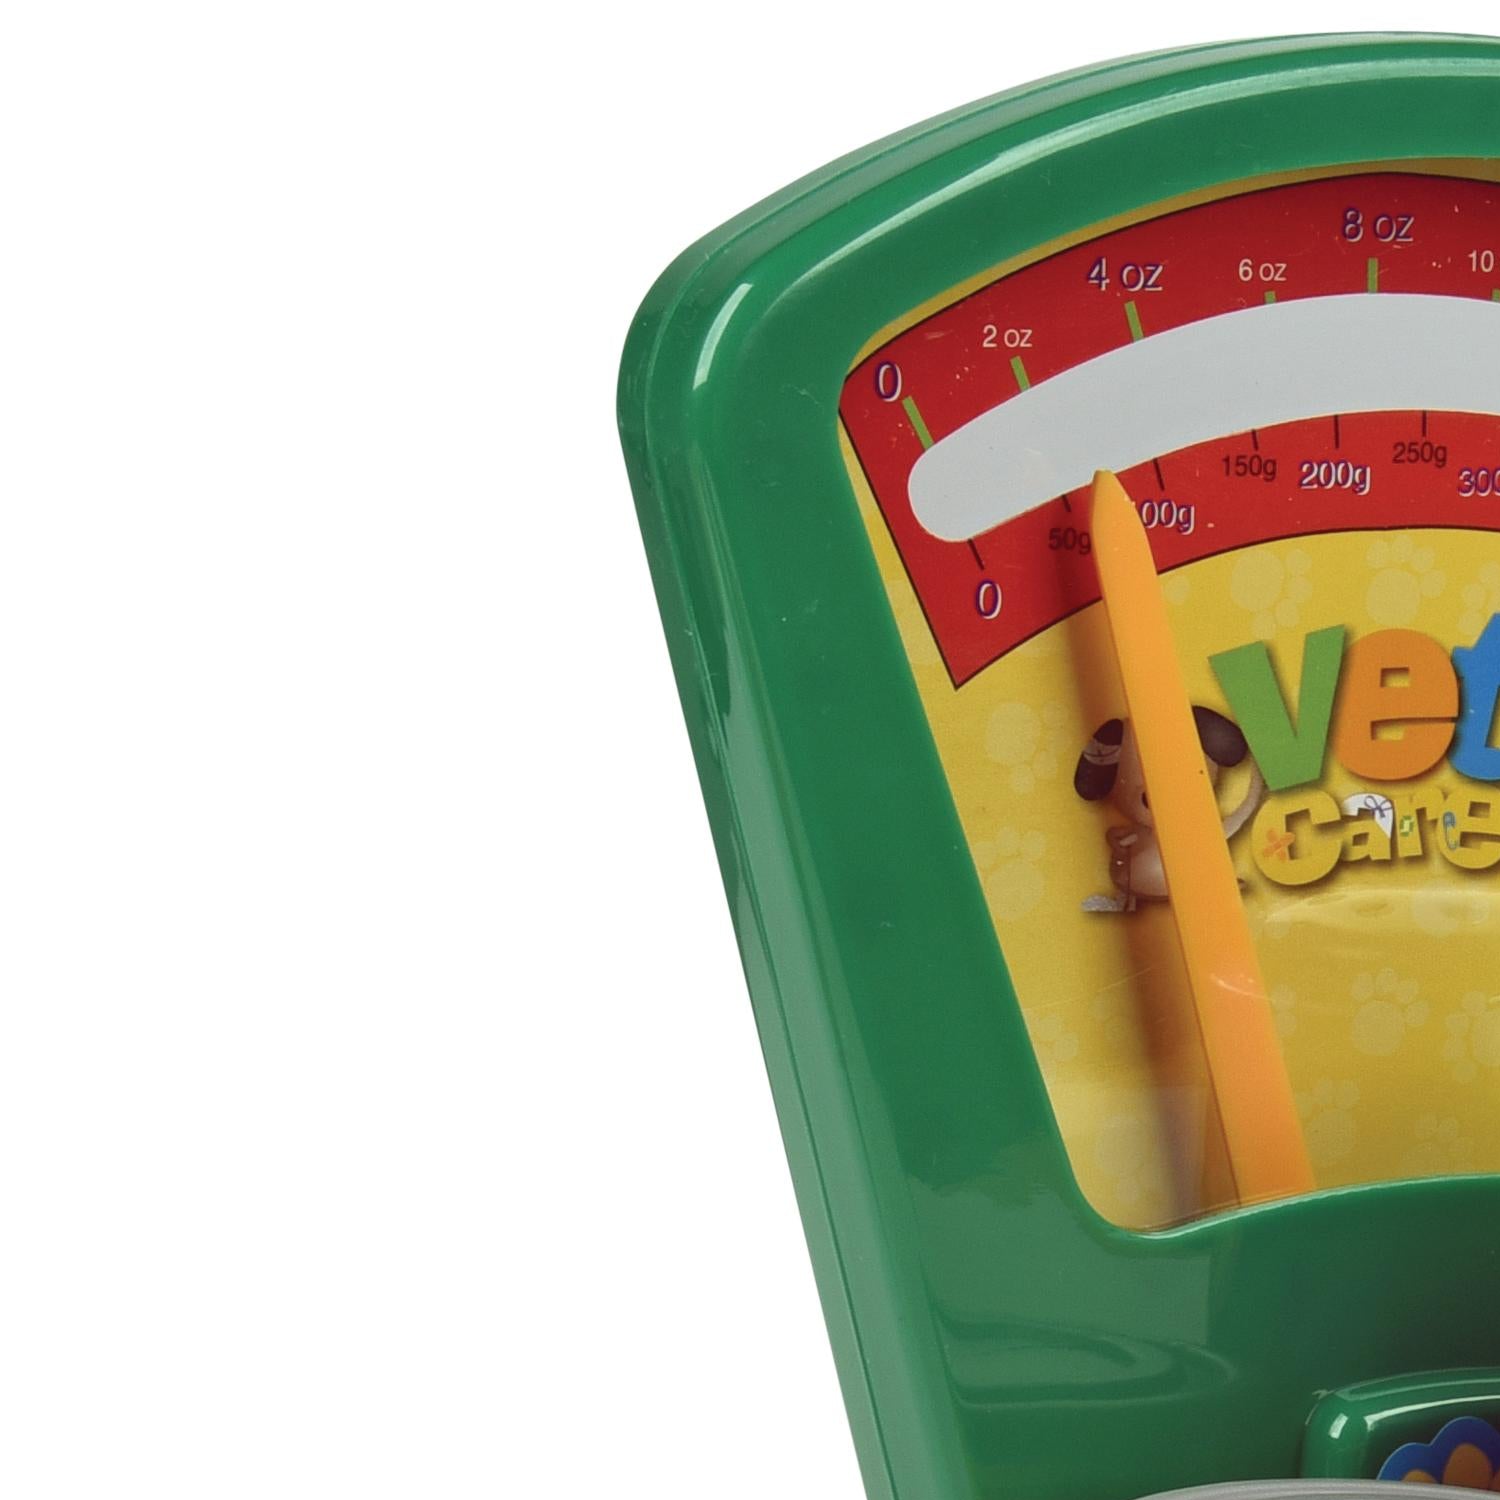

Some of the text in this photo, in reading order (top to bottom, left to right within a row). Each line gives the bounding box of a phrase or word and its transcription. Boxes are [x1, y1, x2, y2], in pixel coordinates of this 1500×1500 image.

[1342, 209, 1415, 243] 8 oz
[1087, 257, 1164, 292] 4 oz
[1238, 260, 1287, 282] 6 oz
[1468, 250, 1495, 273] 10
[982, 326, 1033, 348] 2 oz
[874, 362, 903, 402] 0
[1222, 454, 1277, 481] 150g
[1392, 442, 1448, 468] 250g
[1299, 461, 1371, 496] 200g
[1141, 500, 1196, 536] 00g
[976, 580, 1003, 620] 0
